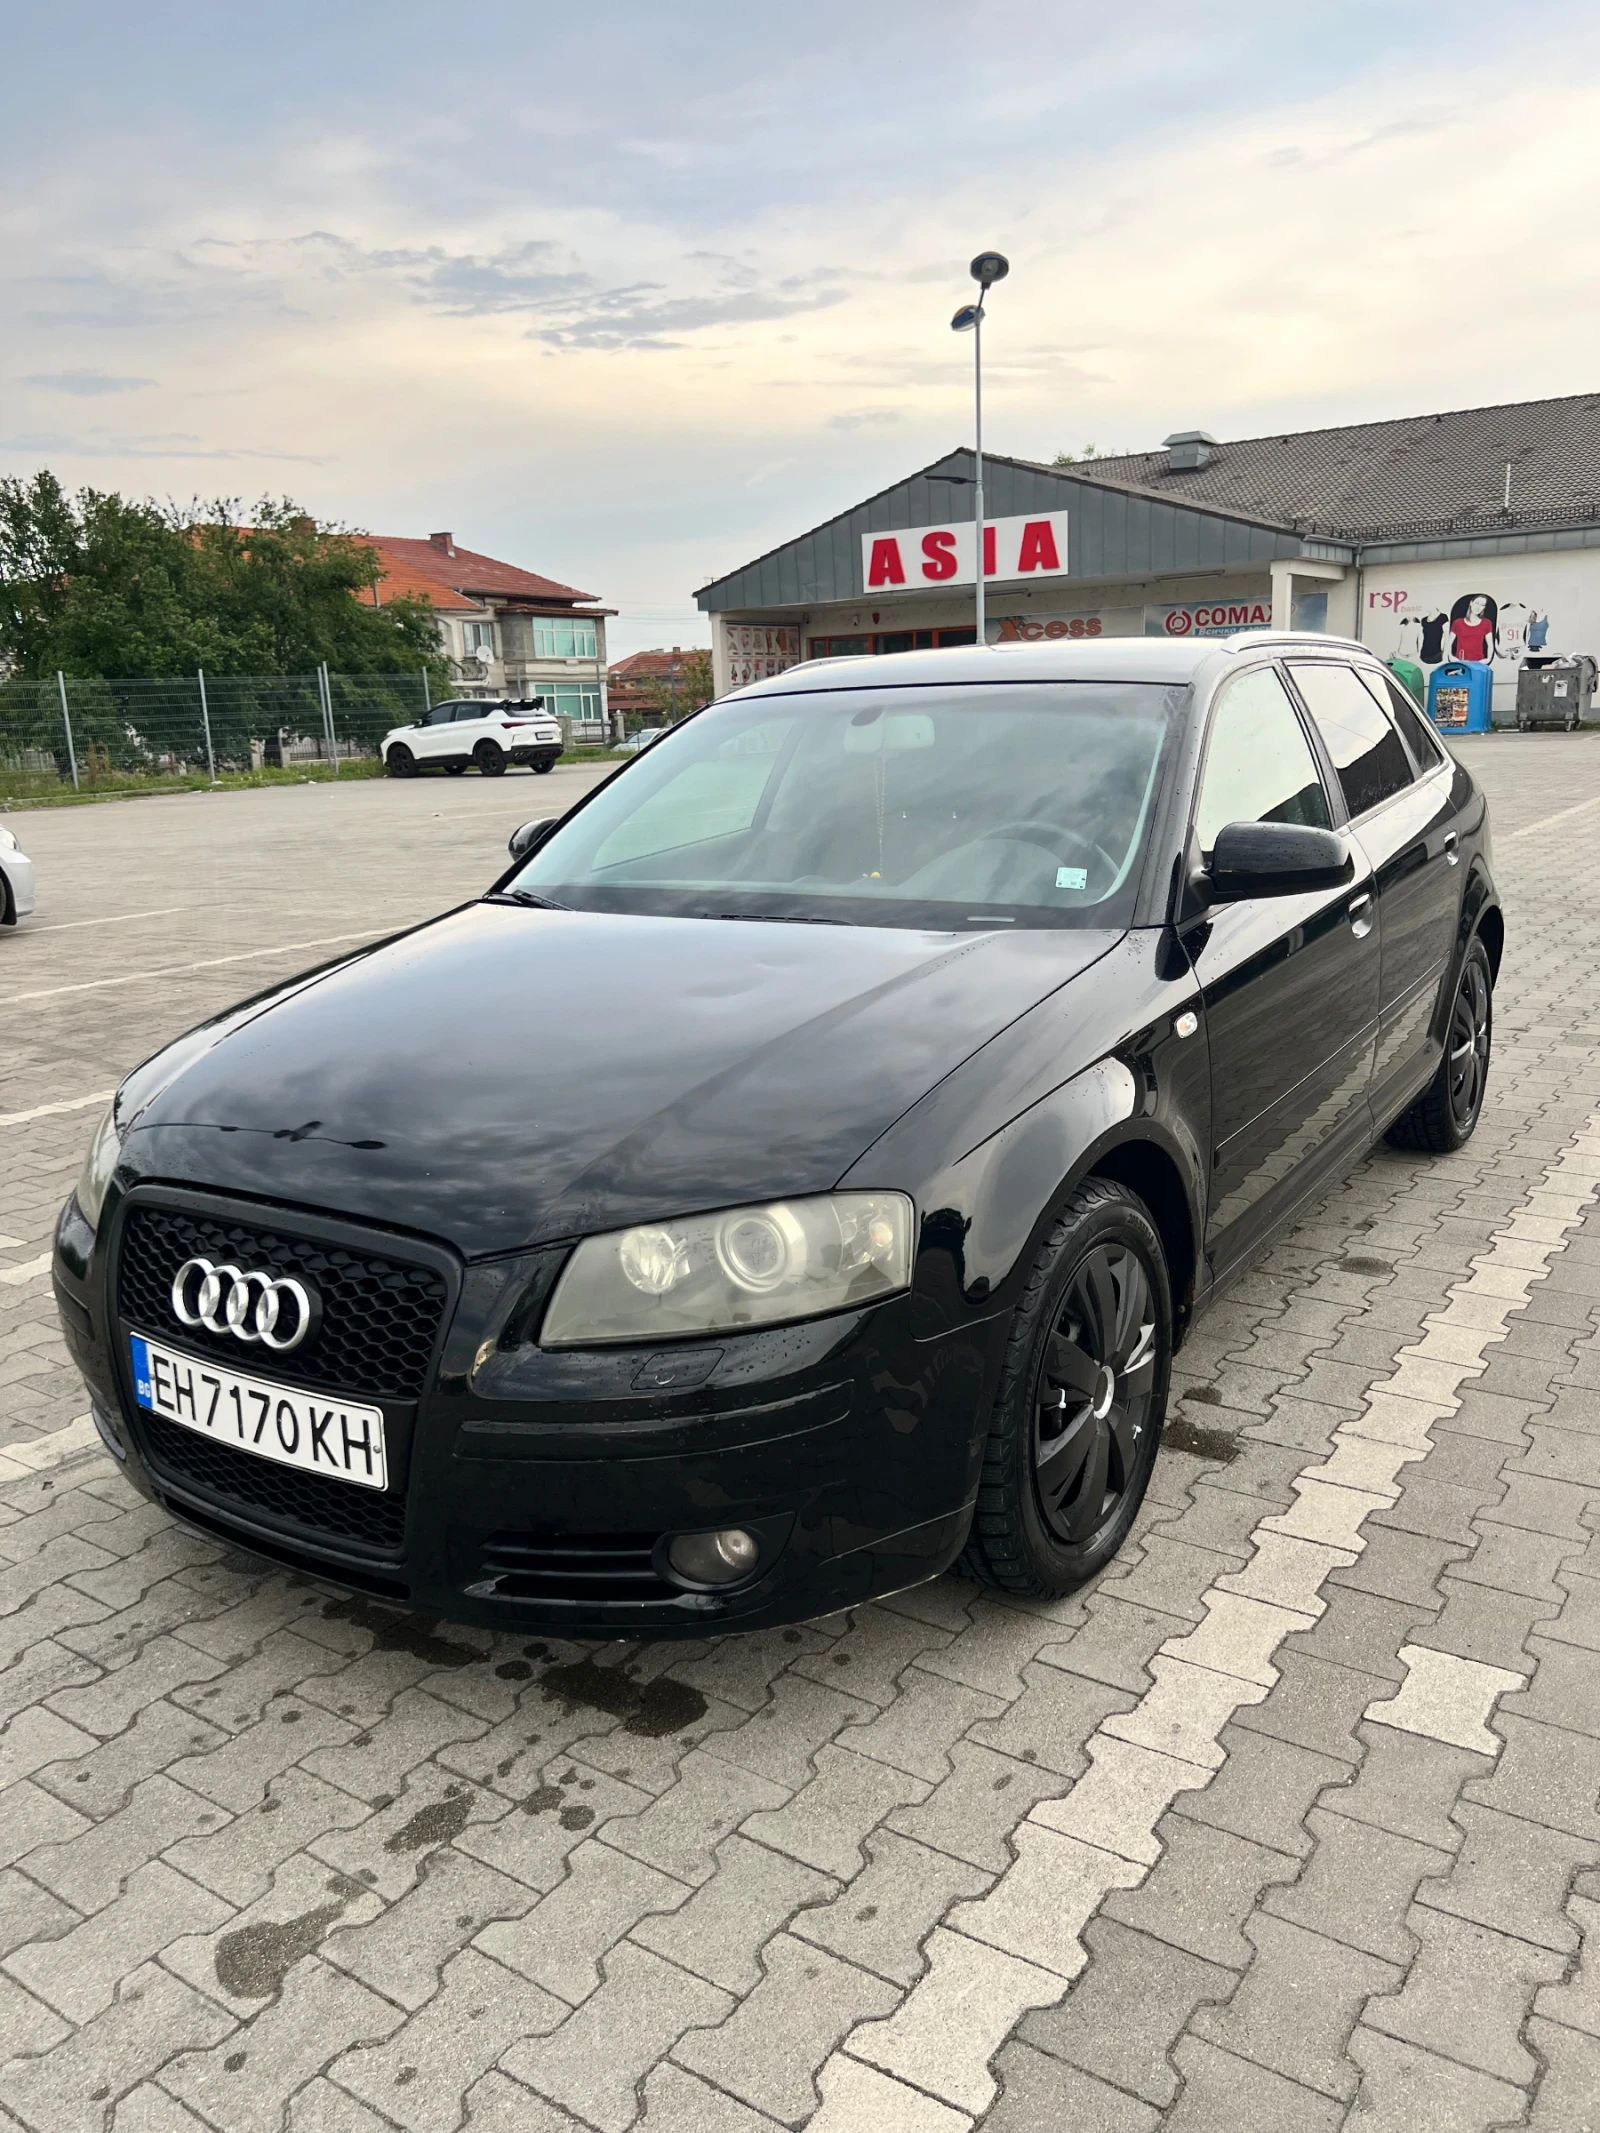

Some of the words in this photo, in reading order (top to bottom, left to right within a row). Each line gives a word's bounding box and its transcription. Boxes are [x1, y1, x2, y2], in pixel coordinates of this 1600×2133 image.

[868, 520, 1060, 587] ASIA
[1369, 590, 1408, 613] rsp
[137, 1378, 151, 1399] BG
